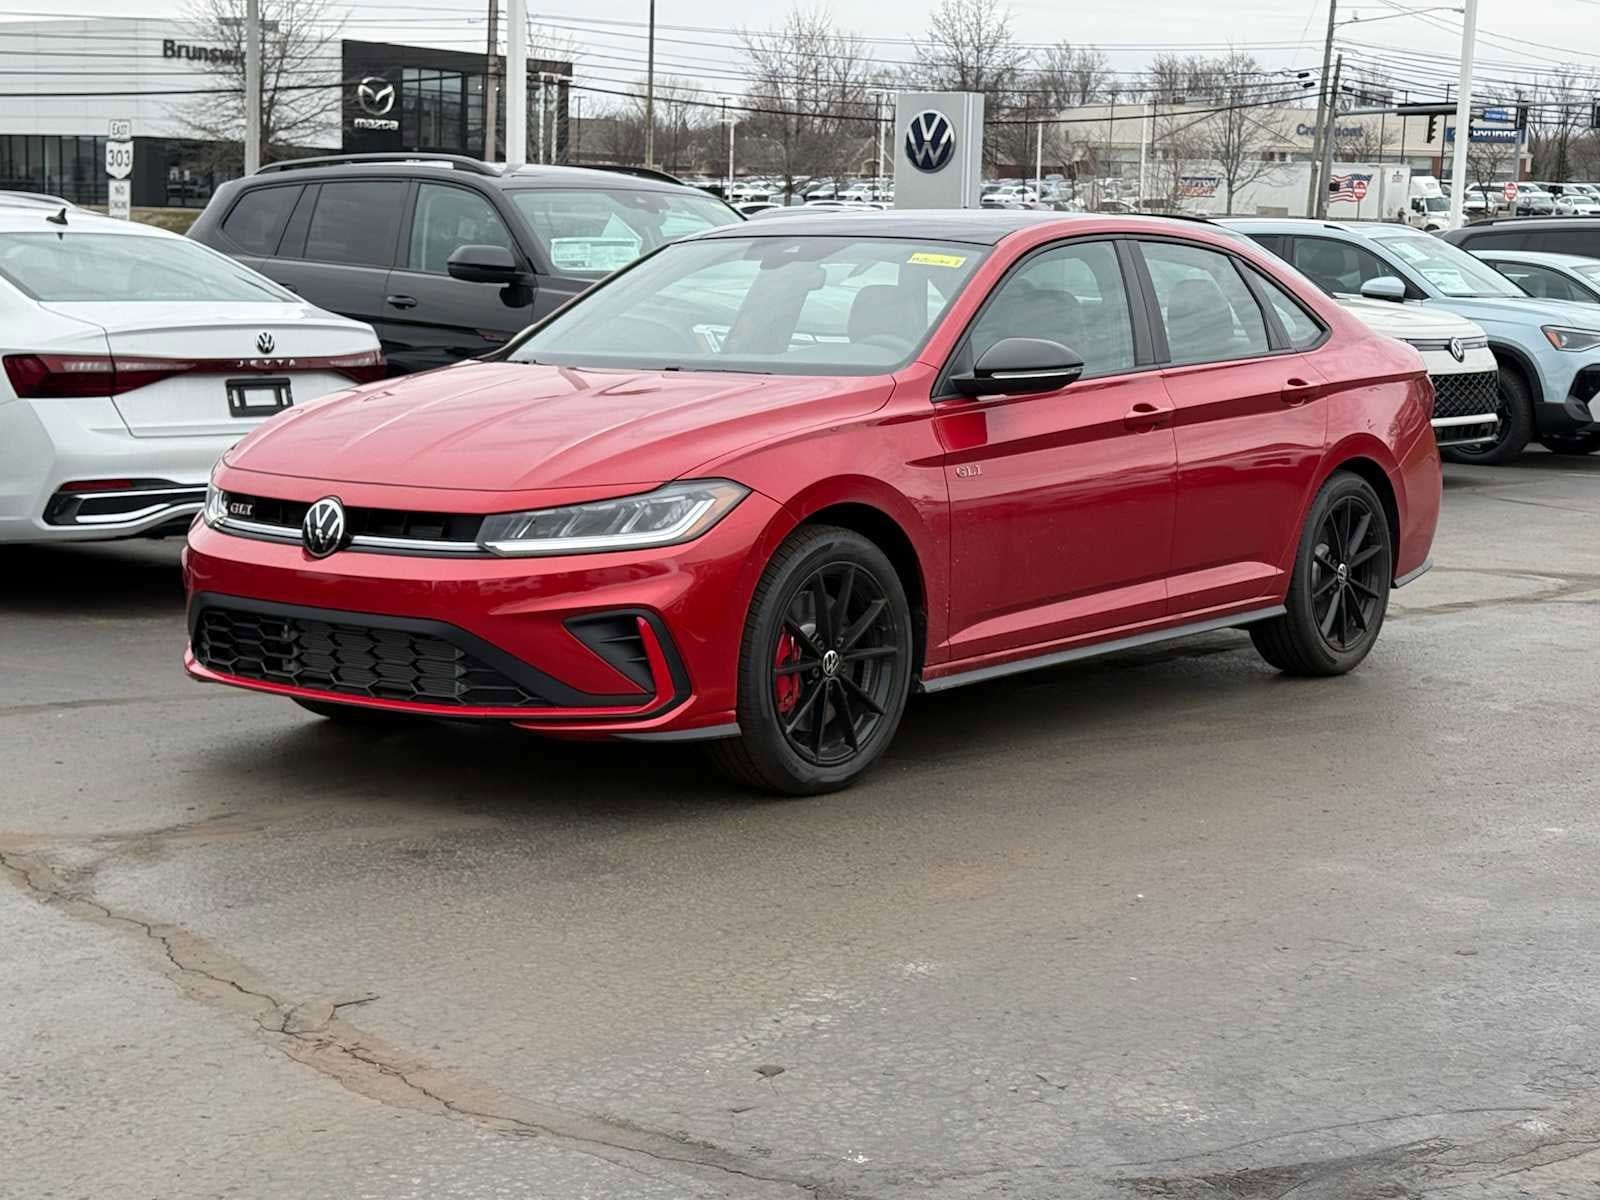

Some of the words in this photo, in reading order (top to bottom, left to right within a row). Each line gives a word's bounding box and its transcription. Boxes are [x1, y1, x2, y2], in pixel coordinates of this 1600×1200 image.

[353, 118, 399, 130] mazda
[108, 150, 130, 167] 303
[236, 359, 297, 368] JETTA
[955, 464, 983, 479] GLI
[229, 502, 253, 516] GLI
